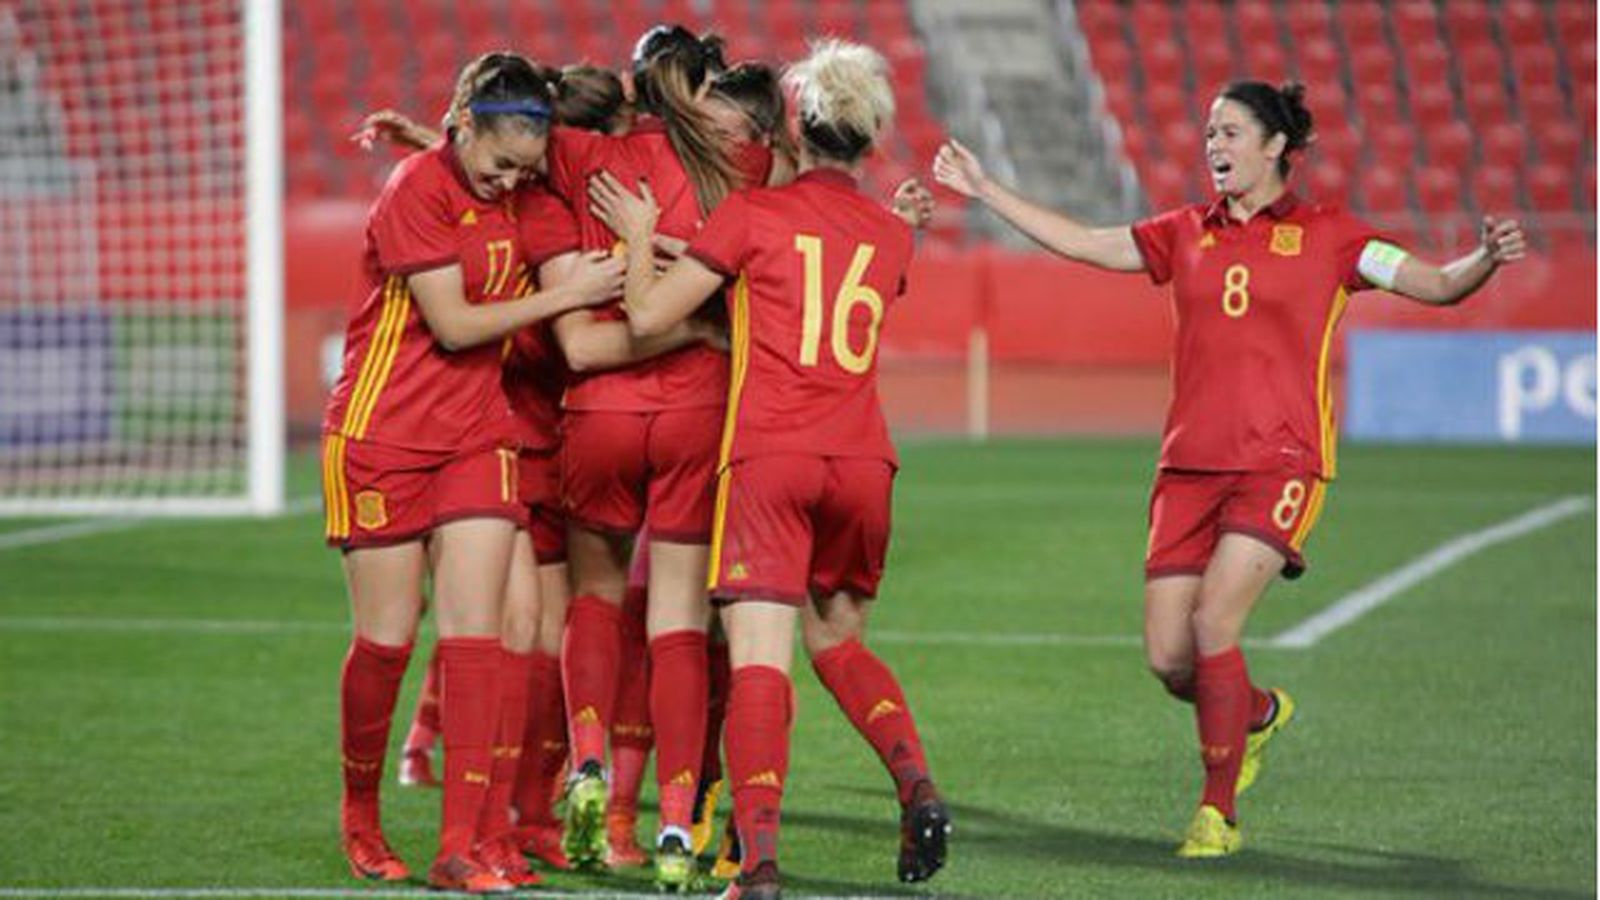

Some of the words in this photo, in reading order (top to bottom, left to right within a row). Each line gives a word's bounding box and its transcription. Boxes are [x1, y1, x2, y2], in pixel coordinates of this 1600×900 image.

[483, 240, 512, 295] 17
[1222, 264, 1249, 318] 8
[795, 234, 885, 375] 16
[1272, 479, 1306, 531] 8
